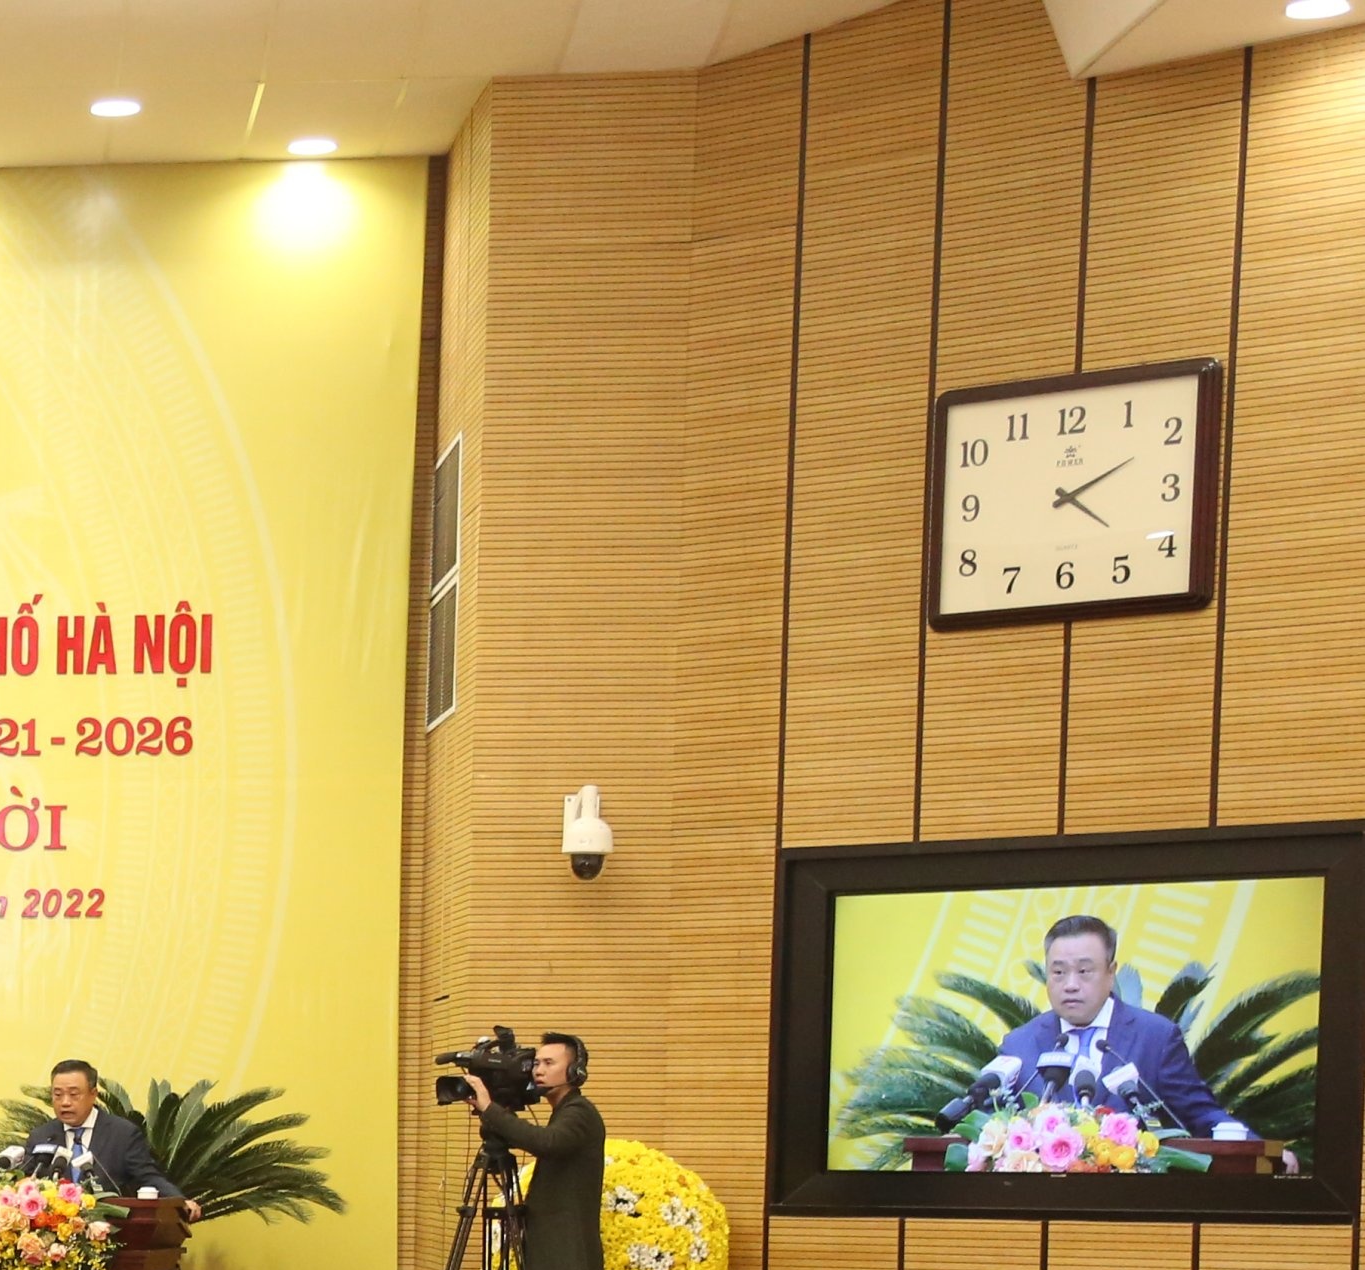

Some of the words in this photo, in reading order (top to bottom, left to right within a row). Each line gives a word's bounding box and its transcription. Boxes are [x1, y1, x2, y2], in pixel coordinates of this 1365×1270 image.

[1006, 413, 1029, 442] 11
[1057, 406, 1087, 436] 12
[1123, 400, 1134, 428] 1
[1164, 417, 1183, 445] 2
[960, 439, 989, 468] 10
[1161, 473, 1181, 502] 3
[961, 495, 980, 522] 9
[1158, 532, 1177, 558] 4
[959, 549, 977, 576] 8
[1056, 562, 1075, 589] 6
[1112, 555, 1131, 583] 5
[1002, 566, 1021, 594] 7
[57, 602, 117, 675] HÀ
[134, 600, 213, 688] NỘI
[75, 715, 194, 757] 2026
[21, 887, 106, 918] 2022
